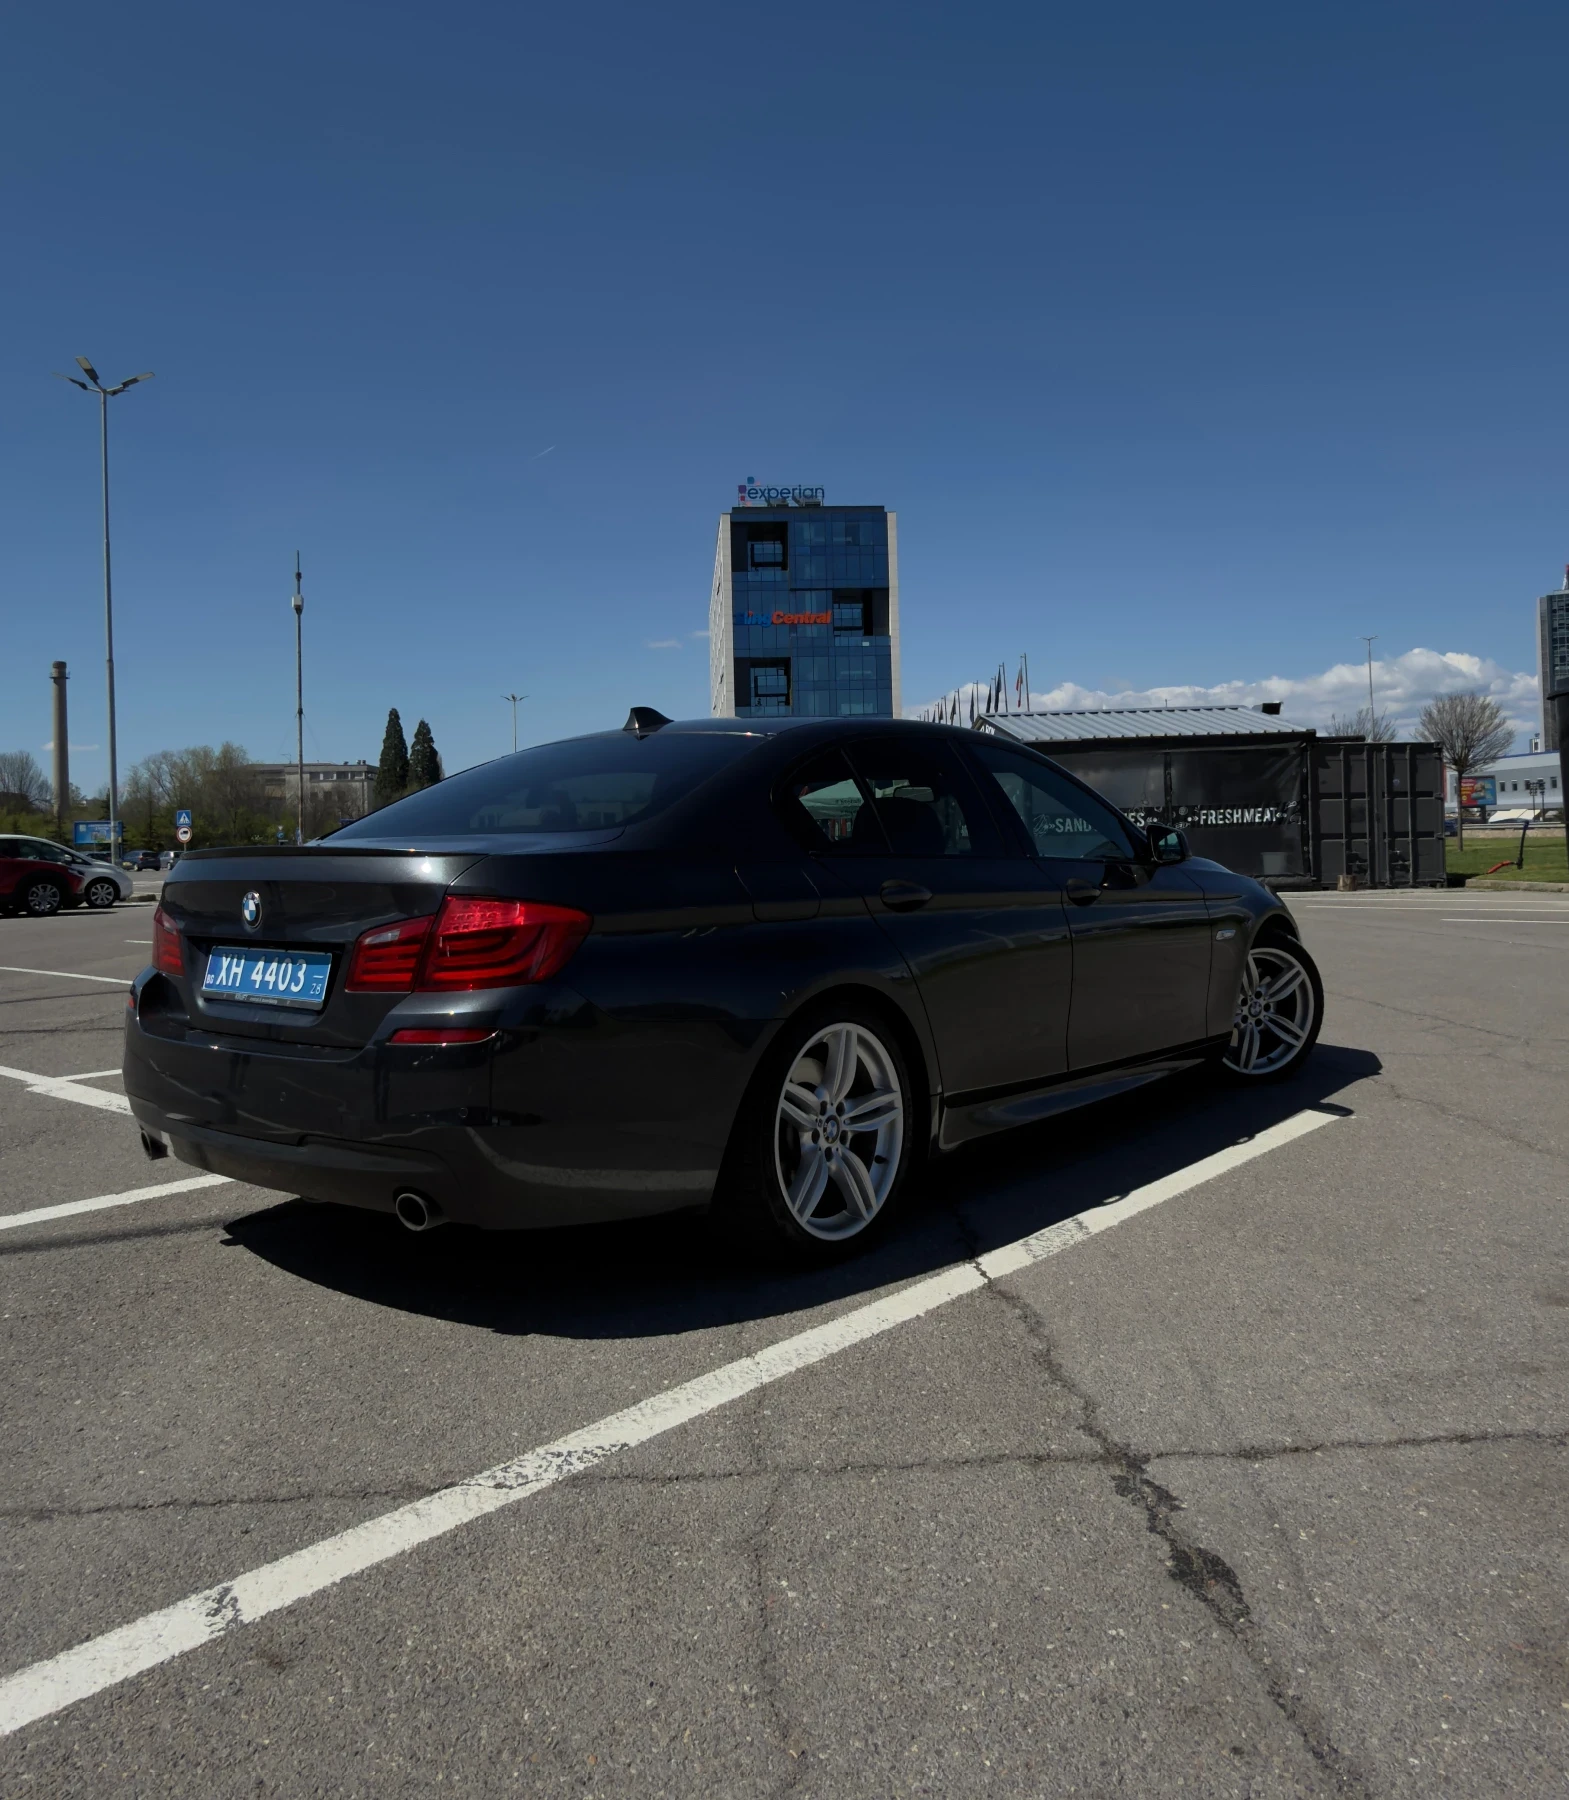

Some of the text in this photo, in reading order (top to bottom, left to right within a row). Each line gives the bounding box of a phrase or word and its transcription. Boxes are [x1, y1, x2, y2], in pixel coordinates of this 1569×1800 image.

[747, 484, 825, 503] experian
[216, 953, 307, 992] XH 4403
